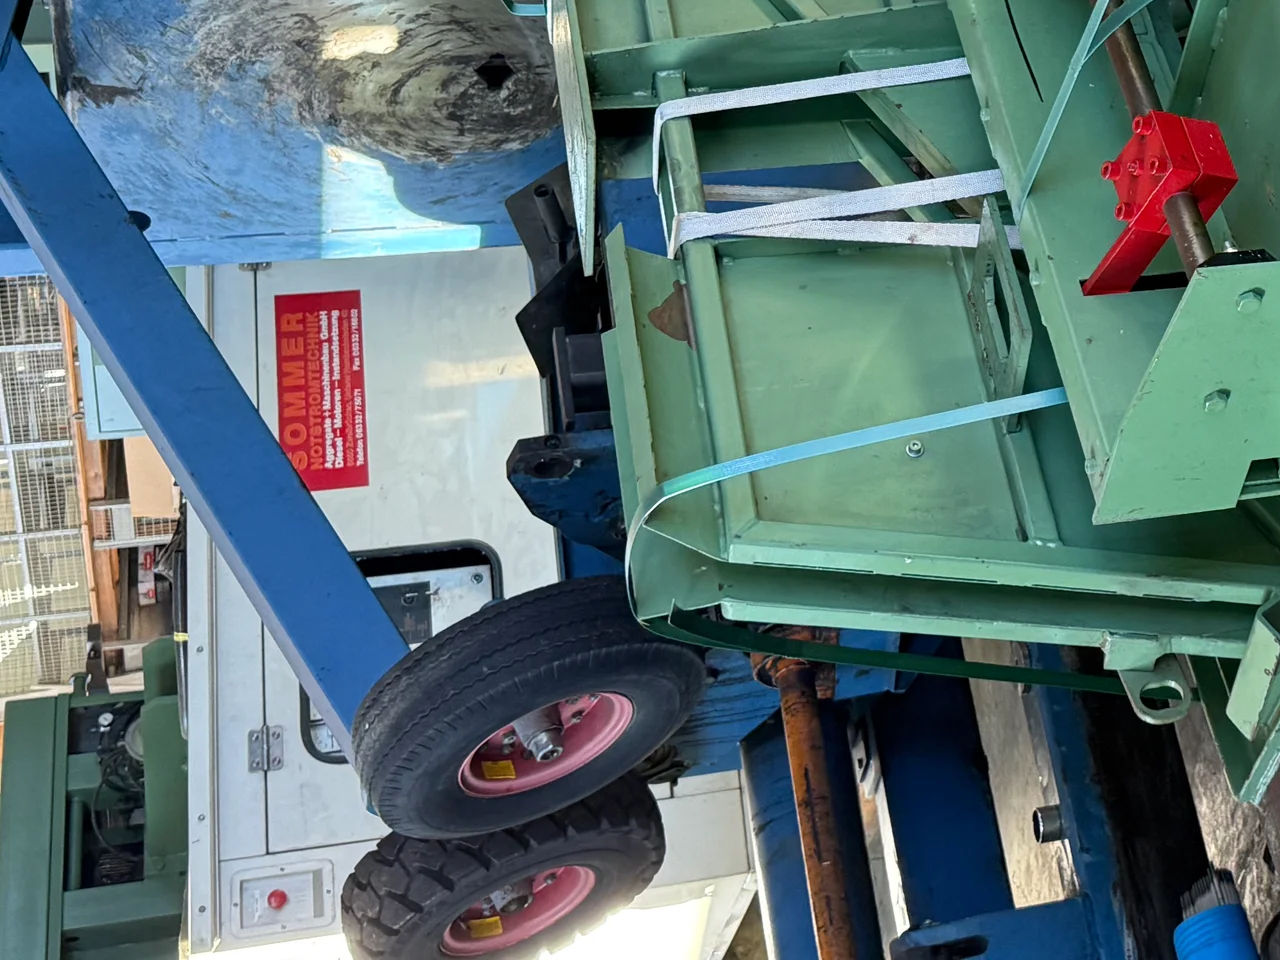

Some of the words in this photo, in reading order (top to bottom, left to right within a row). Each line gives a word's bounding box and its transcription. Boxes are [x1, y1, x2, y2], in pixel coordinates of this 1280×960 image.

[318, 310, 329, 340] GmbH
[320, 342, 332, 410] Maschinenbau
[350, 357, 360, 371] Fax
[279, 312, 308, 471] SOMMER
[305, 311, 324, 471] NOTSTROMTECHNIK
[332, 388, 343, 428] Motoren
[323, 417, 335, 468] Aggregate
[334, 437, 344, 468] Diesel
[355, 439, 365, 466] Telefon
